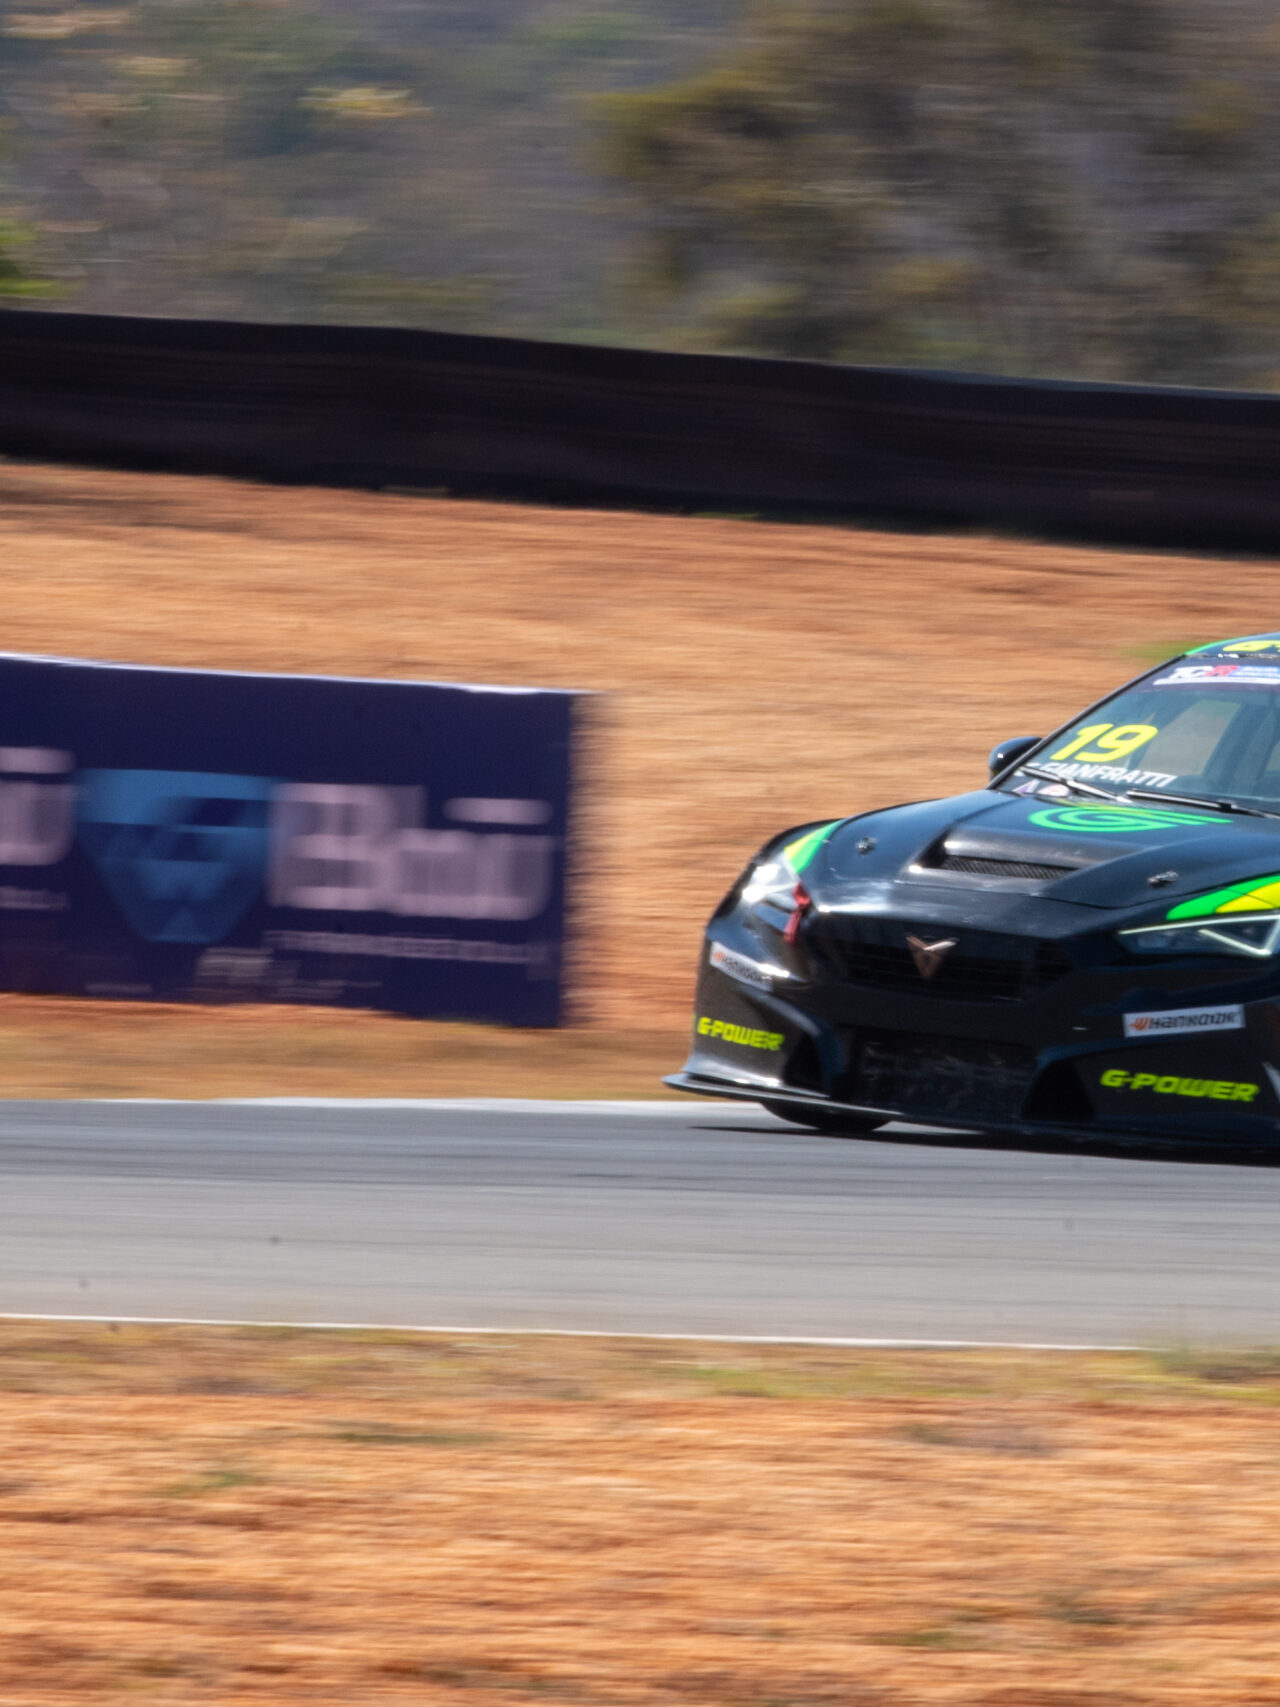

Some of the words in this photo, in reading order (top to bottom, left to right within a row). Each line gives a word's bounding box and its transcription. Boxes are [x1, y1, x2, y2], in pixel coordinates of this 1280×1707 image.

[1050, 724, 1159, 762] 19
[697, 1017, 785, 1051] G-POWER
[1100, 1069, 1260, 1102] G-POWER
